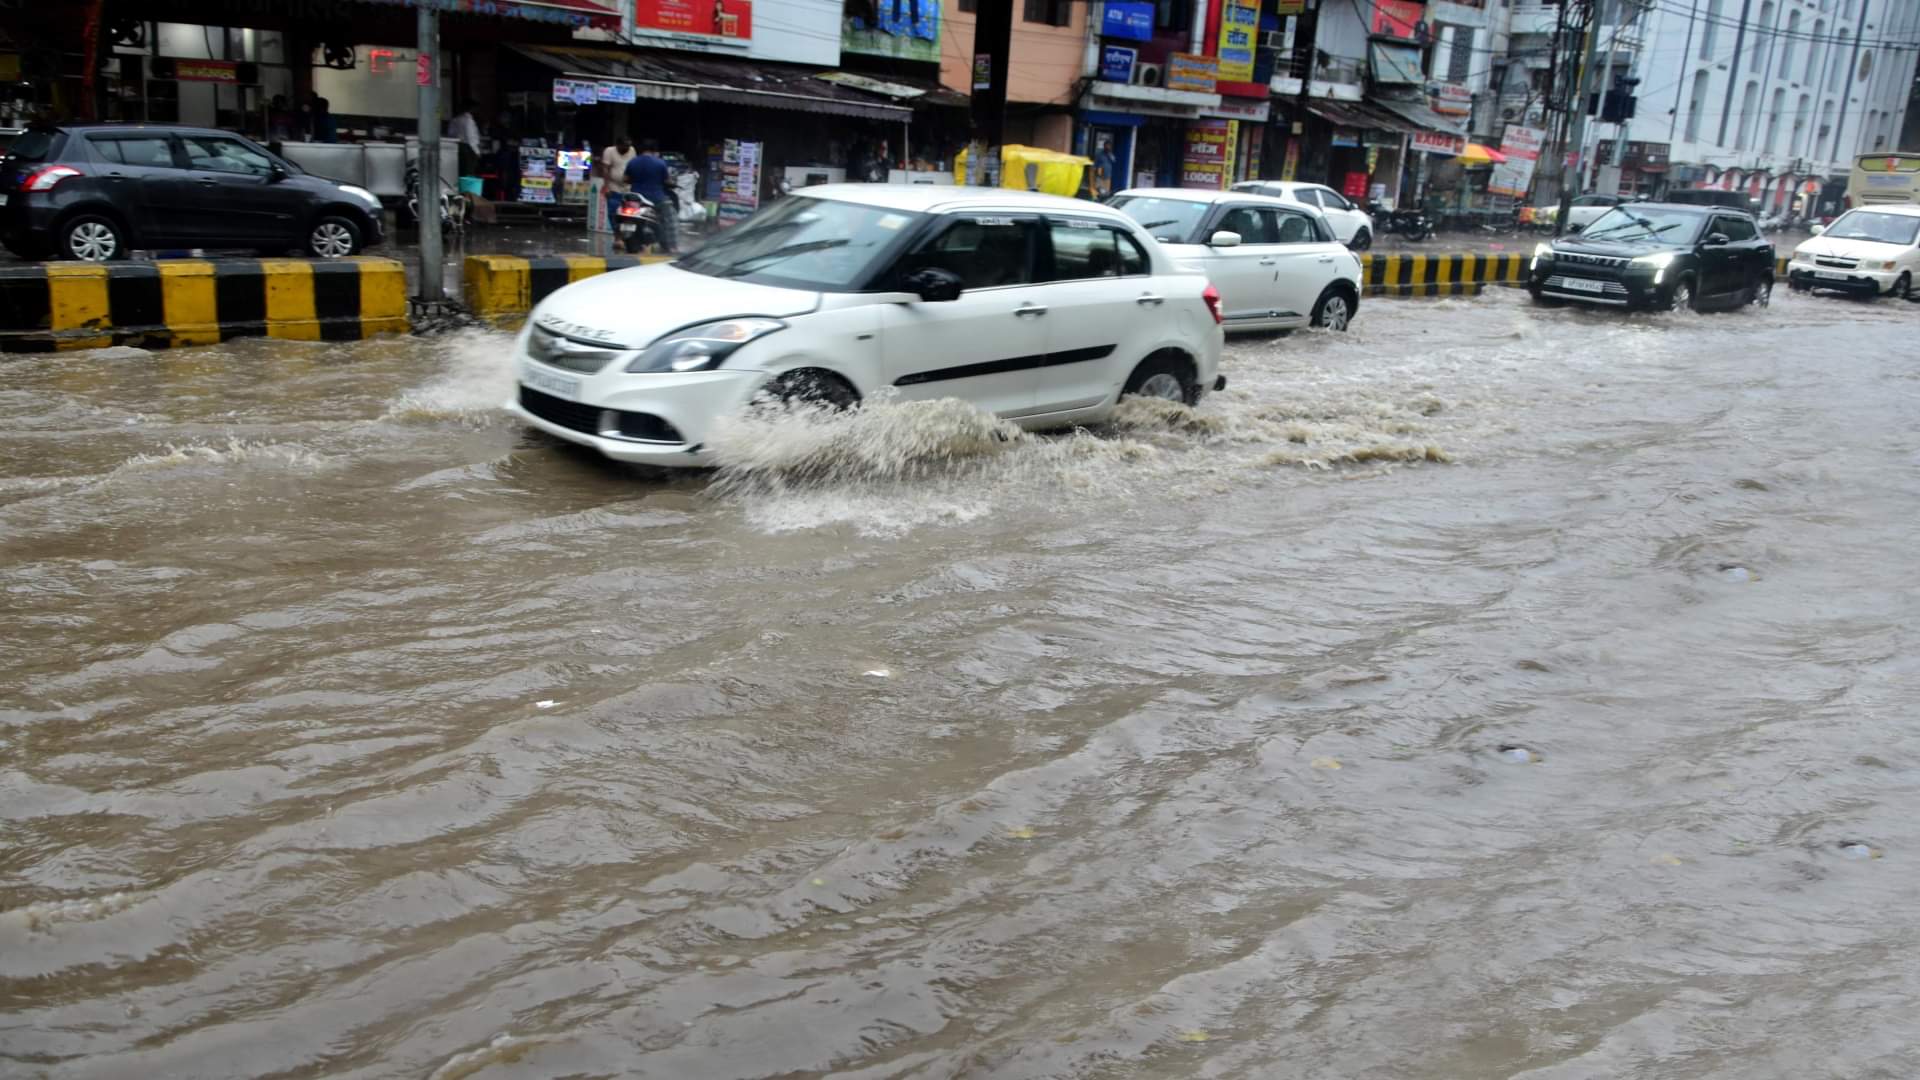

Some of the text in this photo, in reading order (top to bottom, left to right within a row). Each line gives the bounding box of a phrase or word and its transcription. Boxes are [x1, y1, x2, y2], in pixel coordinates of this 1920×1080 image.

[1107, 8, 1123, 22] ATM
[1415, 130, 1452, 147] EXIDE
[1184, 171, 1218, 183] LODGE
